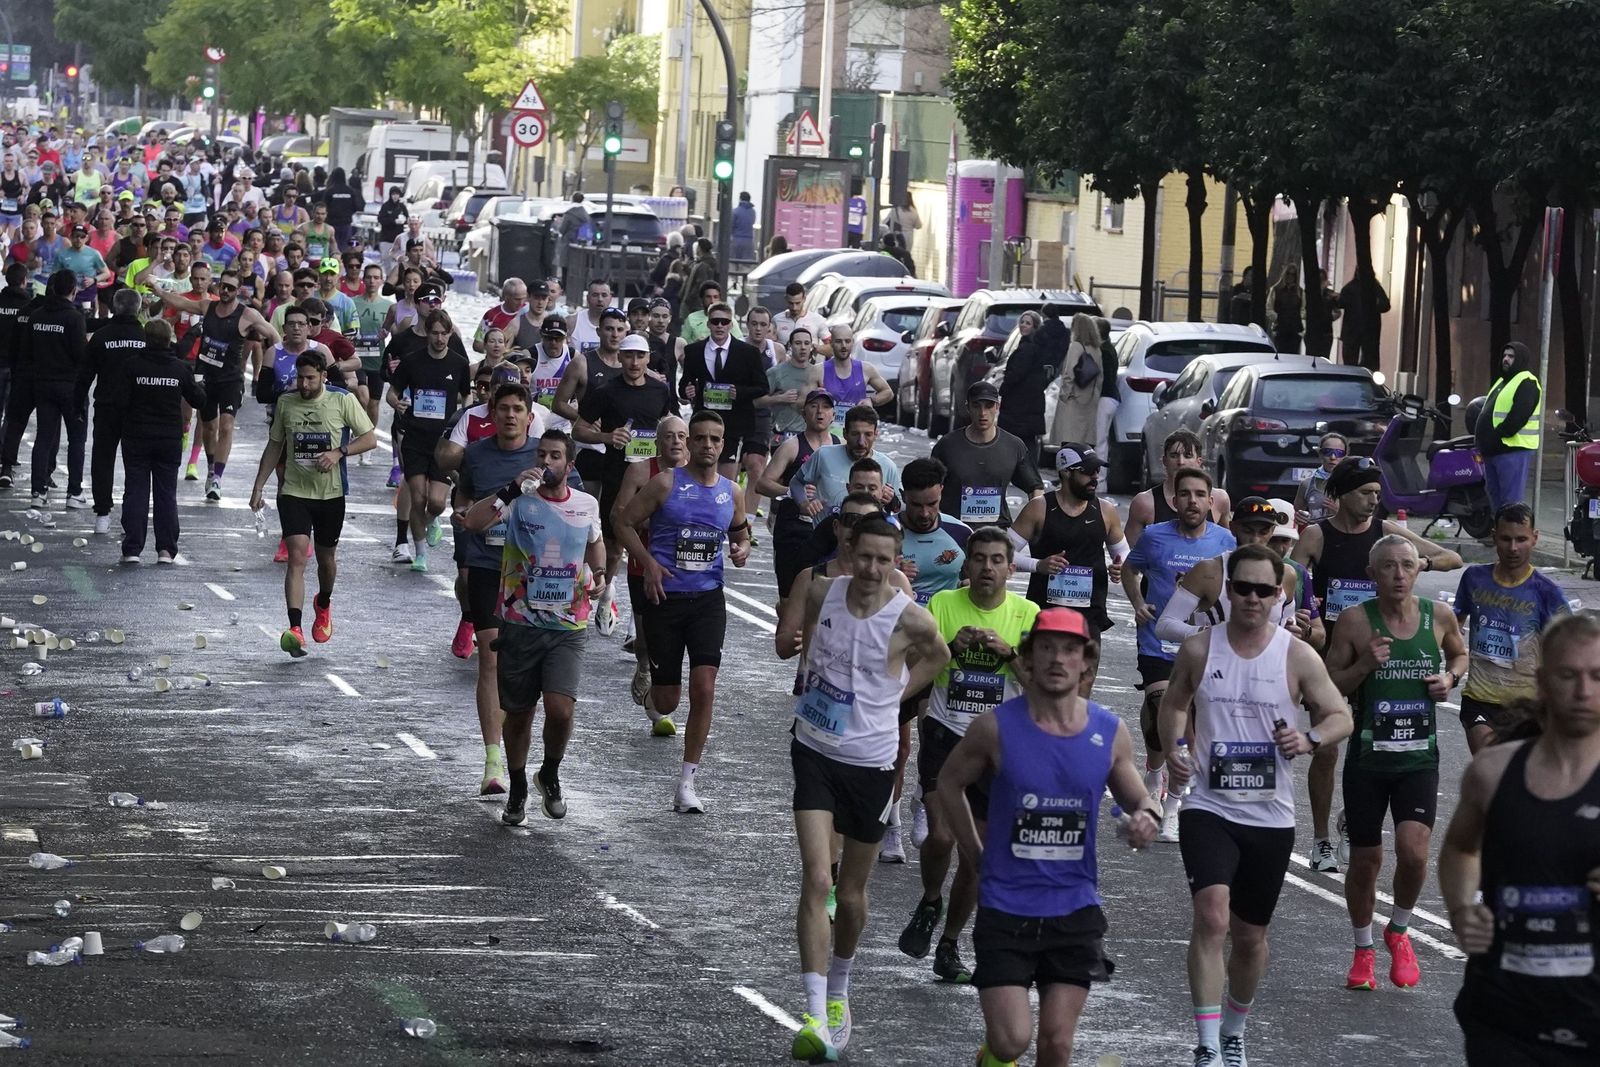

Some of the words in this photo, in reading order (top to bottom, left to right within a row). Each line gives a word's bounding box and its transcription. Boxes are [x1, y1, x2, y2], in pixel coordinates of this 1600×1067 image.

[519, 124, 539, 135] 30
[33, 323, 65, 333] VOLUNTEER
[105, 340, 146, 349] VOLUNTEER
[136, 377, 179, 387] VOLUNTEER
[537, 378, 561, 388] MAD
[966, 506, 996, 514] ARTURO
[693, 530, 718, 538] ZURICH
[676, 550, 705, 561] MIGUEL
[1064, 567, 1089, 575] ZURICH
[1343, 581, 1372, 590] ZURICH
[533, 590, 567, 600] JUANMI
[1487, 633, 1504, 642] 6270
[1381, 659, 1435, 669] ORTHCAWL
[967, 674, 1000, 685] ZURICH
[820, 682, 848, 702] ZURICH
[966, 689, 985, 699] 5125
[1393, 702, 1425, 711] ZURICH
[1395, 718, 1412, 726] 4614
[1390, 728, 1416, 740] JEFF
[1231, 745, 1268, 754] ZURICH
[1220, 774, 1265, 788] PIETRO
[1041, 797, 1083, 808] ZURICH
[1041, 816, 1064, 827] 3794
[1019, 828, 1082, 844] CHARLOT
